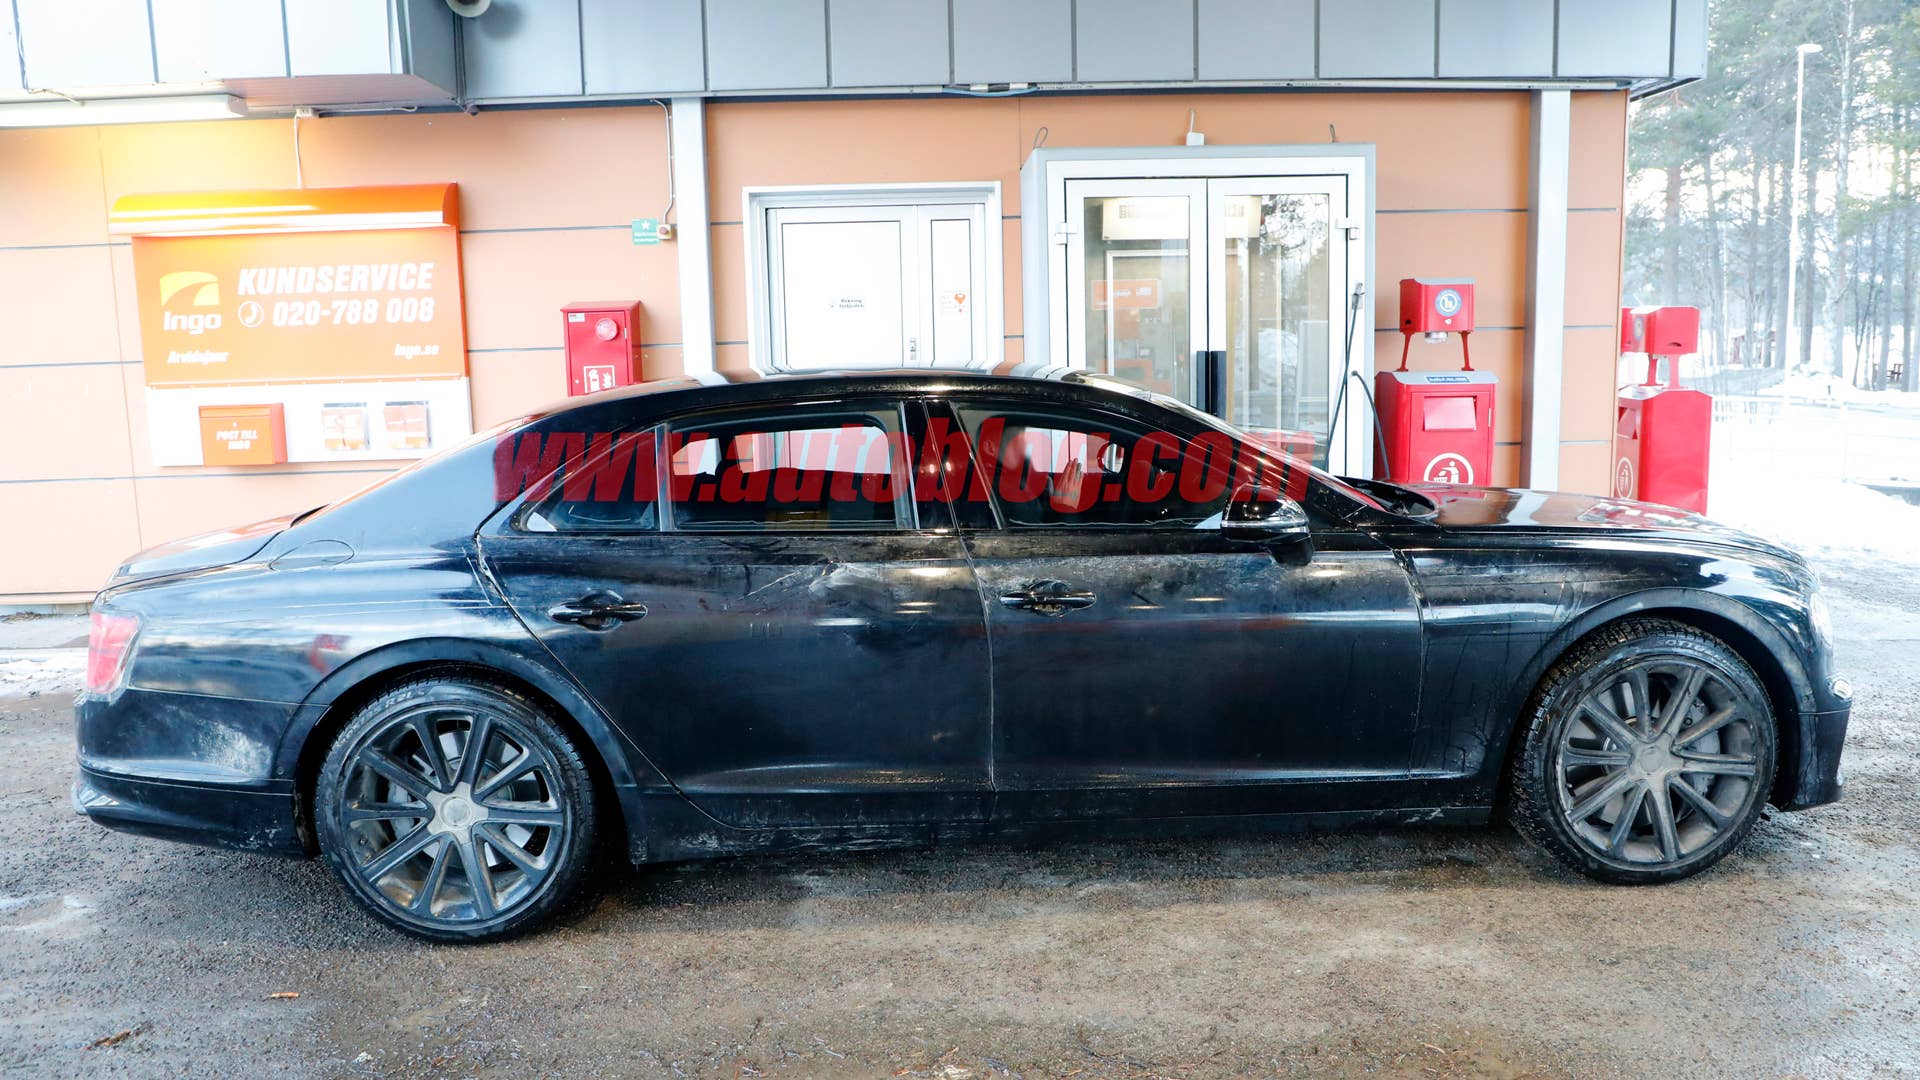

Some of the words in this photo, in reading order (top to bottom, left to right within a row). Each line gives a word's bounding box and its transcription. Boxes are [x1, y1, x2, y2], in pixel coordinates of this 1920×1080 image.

[238, 262, 435, 295] KUNDSERVICE
[163, 312, 222, 335] Ingo
[273, 300, 379, 327] 020-788
[386, 297, 435, 323] 008
